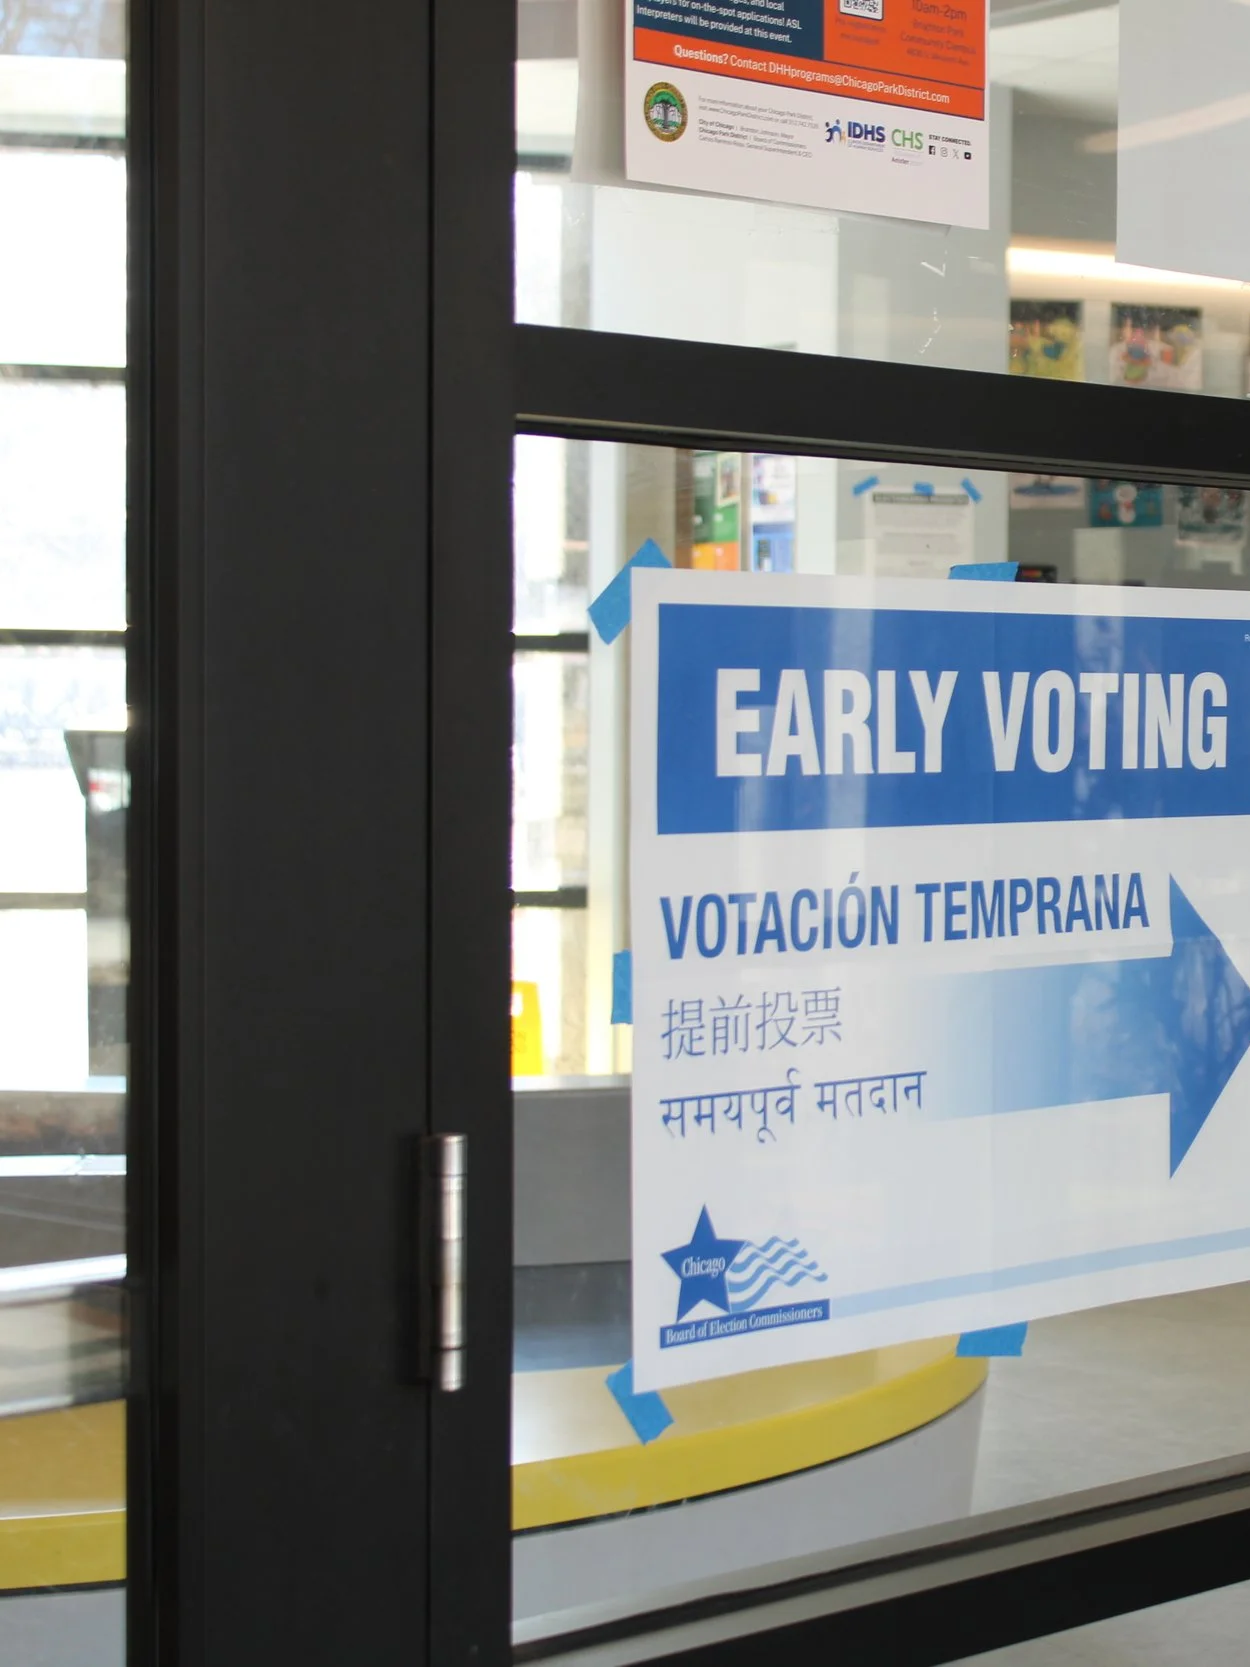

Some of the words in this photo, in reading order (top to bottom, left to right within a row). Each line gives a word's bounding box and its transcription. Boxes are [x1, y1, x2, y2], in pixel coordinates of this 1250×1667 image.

[637, 4, 683, 22] Interpreters
[684, 14, 698, 25] will
[699, 17, 710, 28] be
[710, 20, 744, 34] provided
[744, 27, 753, 36] at
[753, 28, 769, 39] this
[769, 33, 792, 43] event.
[691, 2, 736, 17] on-the-spot
[737, 10, 785, 26] applications!
[786, 18, 802, 30] ASL
[766, 0, 785, 11] local
[673, 44, 729, 64] Questions?
[730, 54, 768, 71] Contact
[769, 61, 950, 104] DHHprograms@ChicagoParkDistrict.com
[847, 121, 886, 143] IDHS
[891, 128, 924, 150] CHS
[928, 134, 941, 142] STAY
[715, 668, 958, 778] EARLY
[982, 669, 1228, 774] VOTING
[660, 871, 899, 960] VOTACIÓN
[915, 872, 1150, 943] TEMPRANA
[661, 986, 842, 1060] 提前投票
[660, 1068, 801, 1144] समयपूर्व
[814, 1072, 927, 1120] मतदान
[681, 1256, 726, 1278] Chicago
[665, 1326, 696, 1345] Board
[697, 1320, 708, 1338] of
[710, 1316, 748, 1337] Election
[749, 1306, 823, 1329] Commissioners
